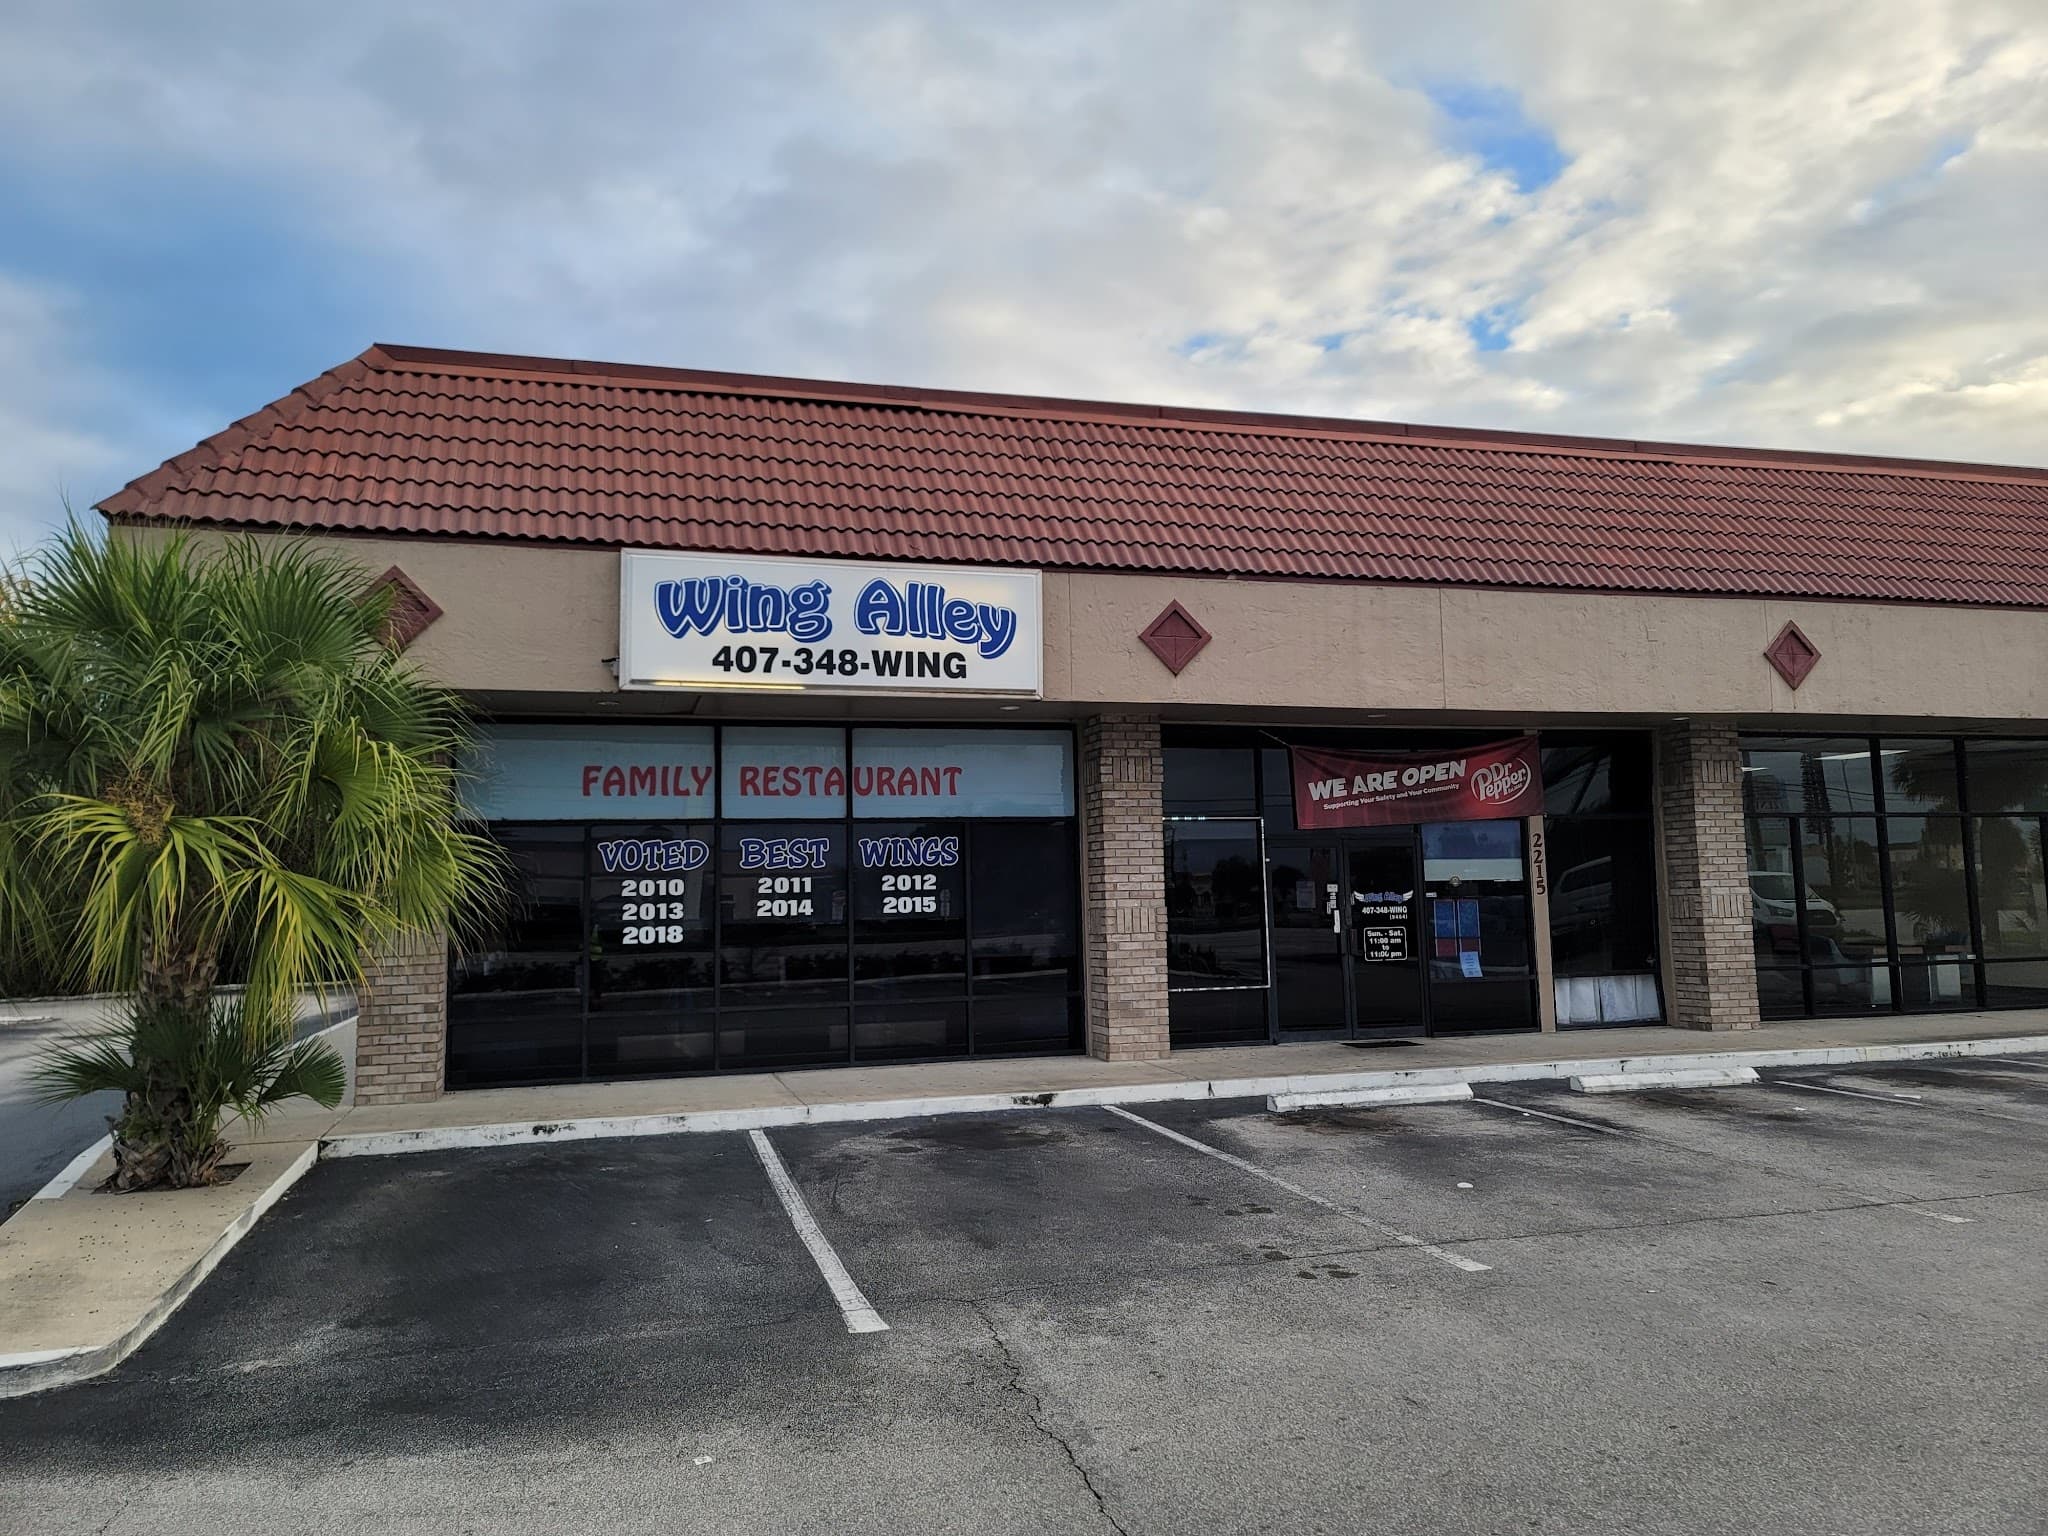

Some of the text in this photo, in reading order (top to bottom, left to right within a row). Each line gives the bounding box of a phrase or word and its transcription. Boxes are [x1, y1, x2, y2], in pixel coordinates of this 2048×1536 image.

[654, 575, 1017, 659] Wing Alley
[712, 645, 967, 679] 407-348-WING
[582, 765, 963, 797] FAMILY RESTAURANT
[1308, 759, 1467, 801] WE ARE OPEN
[1472, 768, 1527, 801] Pepper
[1489, 762, 1513, 782] Dr
[1323, 782, 1460, 811] Supporting Your Safety and Your Community
[598, 836, 959, 871] VOTED BEST WINGS
[1532, 833, 1545, 895] 2215
[621, 874, 937, 897] 2010 2011 2012
[621, 897, 937, 921] 2013 2014 2015
[1362, 906, 1408, 914] 407-348-WING
[622, 926, 684, 945] 2018
